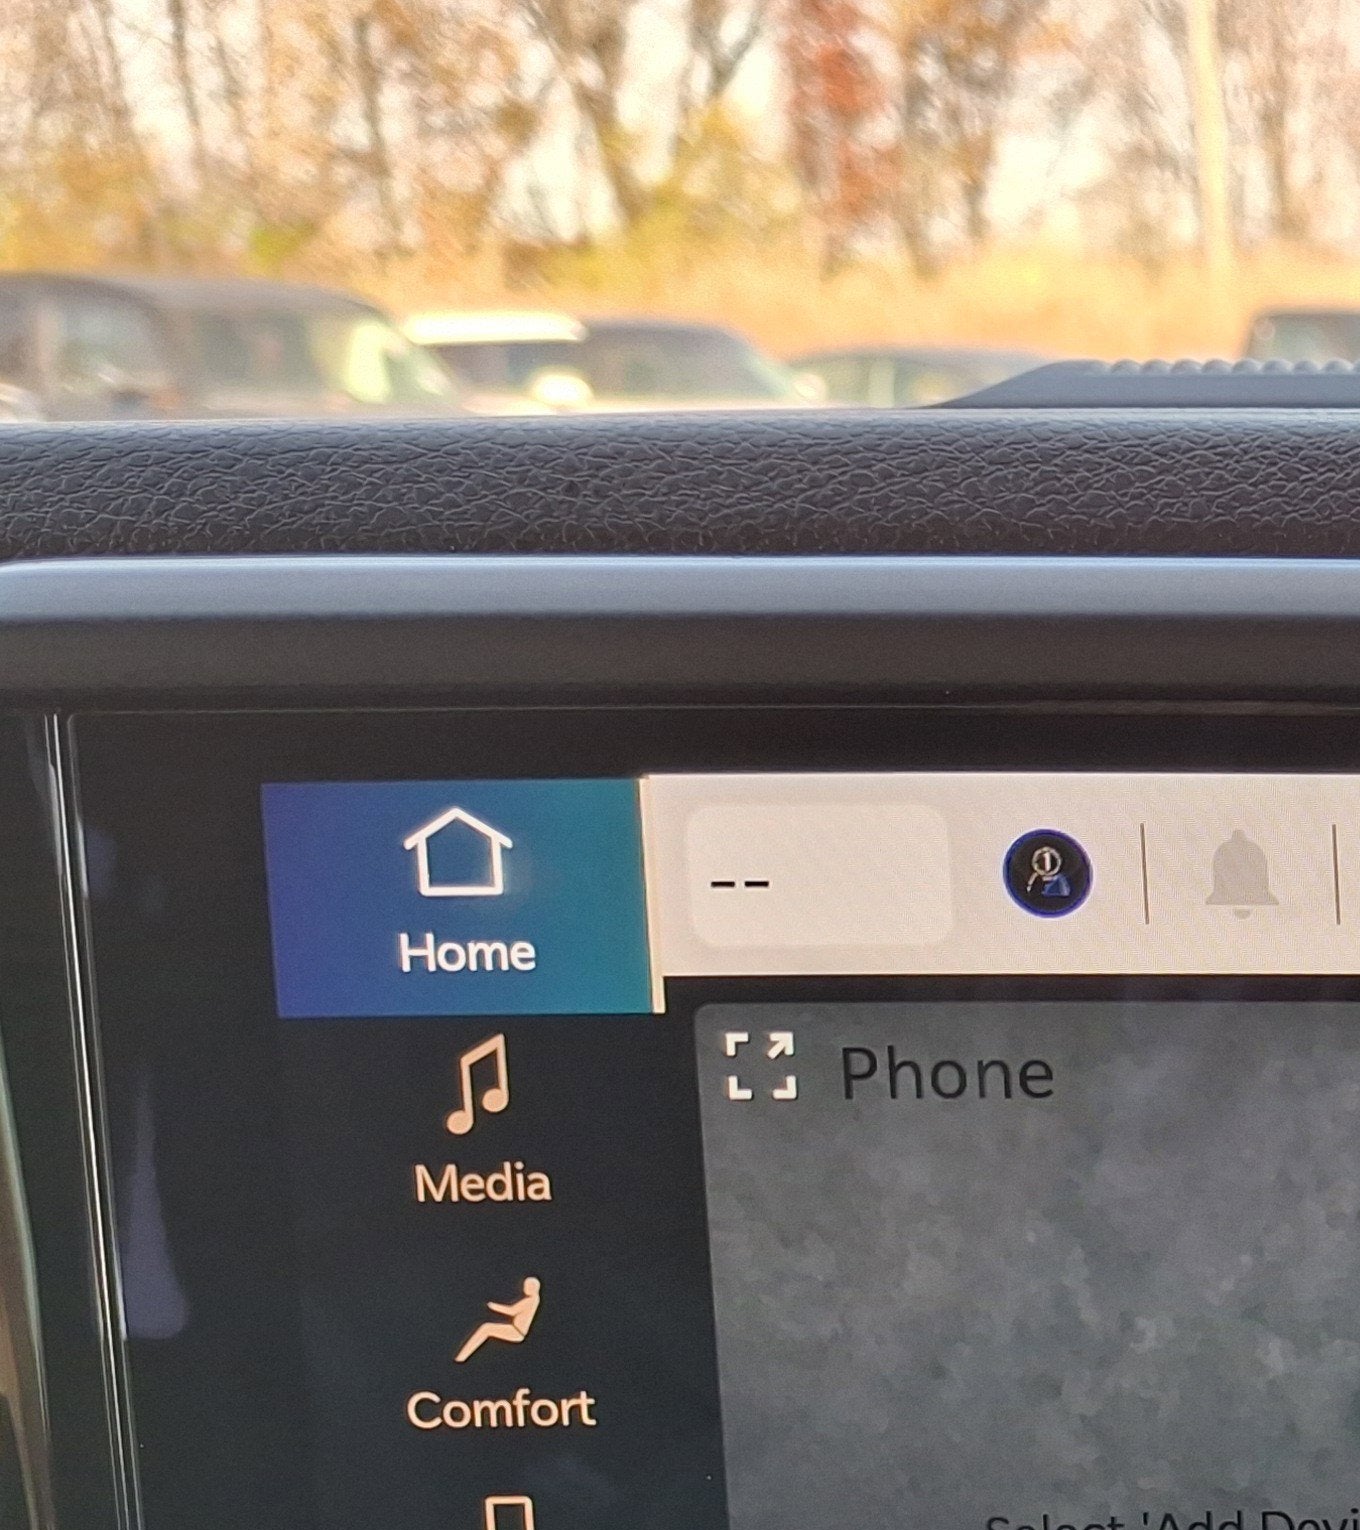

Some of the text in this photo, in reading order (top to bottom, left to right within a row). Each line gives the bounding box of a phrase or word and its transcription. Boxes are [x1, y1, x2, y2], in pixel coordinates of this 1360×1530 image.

[399, 934, 537, 974] Home
[840, 1046, 1055, 1100] Phone
[413, 1162, 552, 1203] Media
[406, 1391, 597, 1430] Comfort
